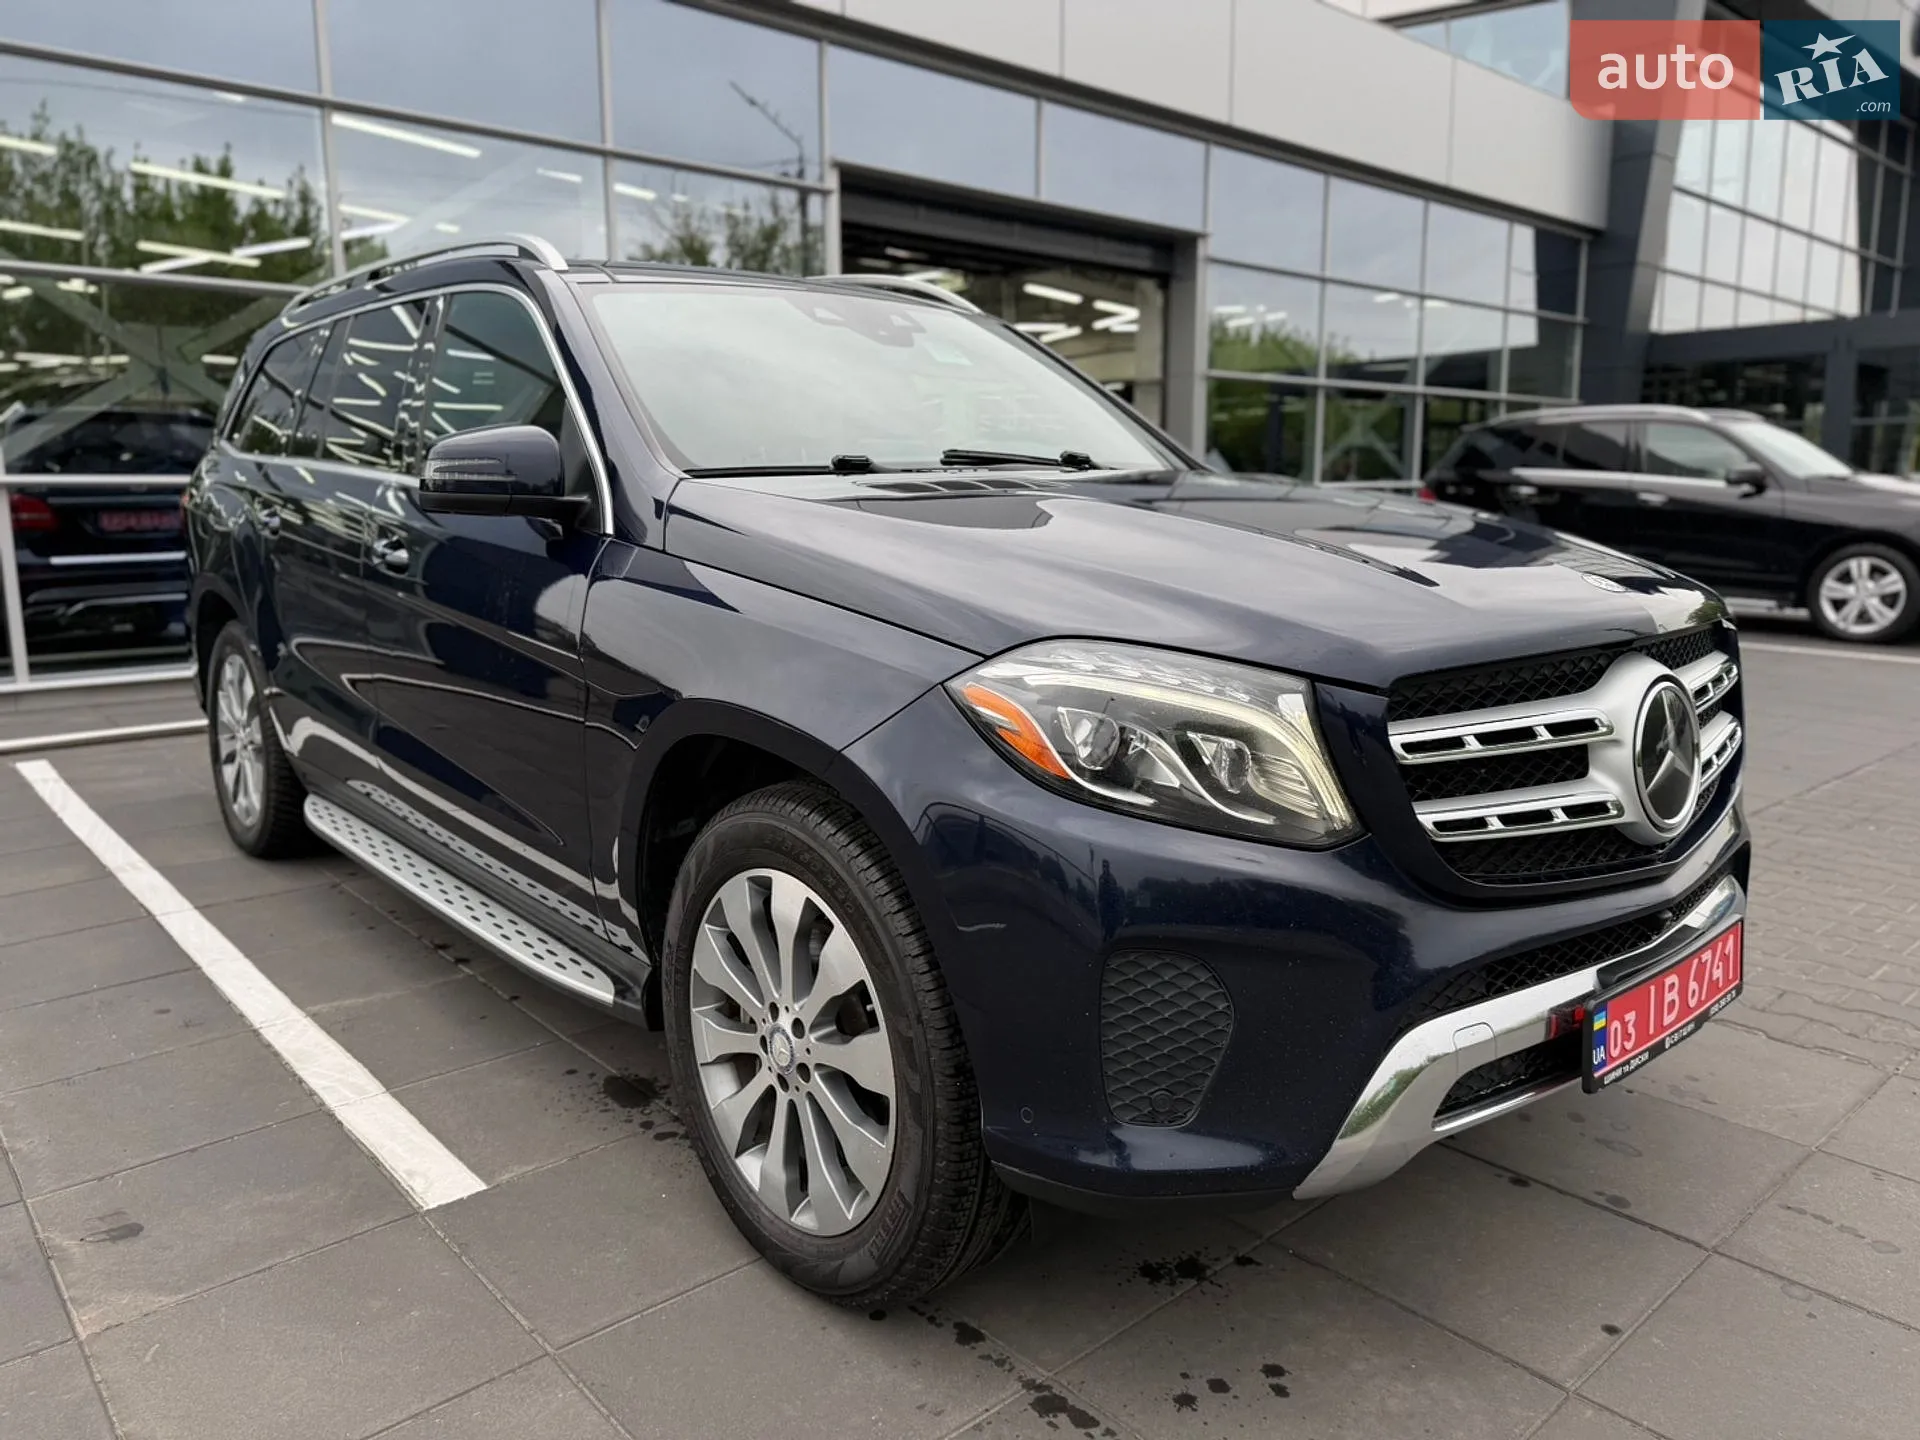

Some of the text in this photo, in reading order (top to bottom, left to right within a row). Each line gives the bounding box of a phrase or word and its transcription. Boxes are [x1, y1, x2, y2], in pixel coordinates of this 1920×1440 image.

[1609, 1010, 1637, 1058] 03
[1648, 973, 1680, 1036] IB
[1687, 934, 1734, 1009] 6741
[1593, 1045, 1606, 1065] UA
